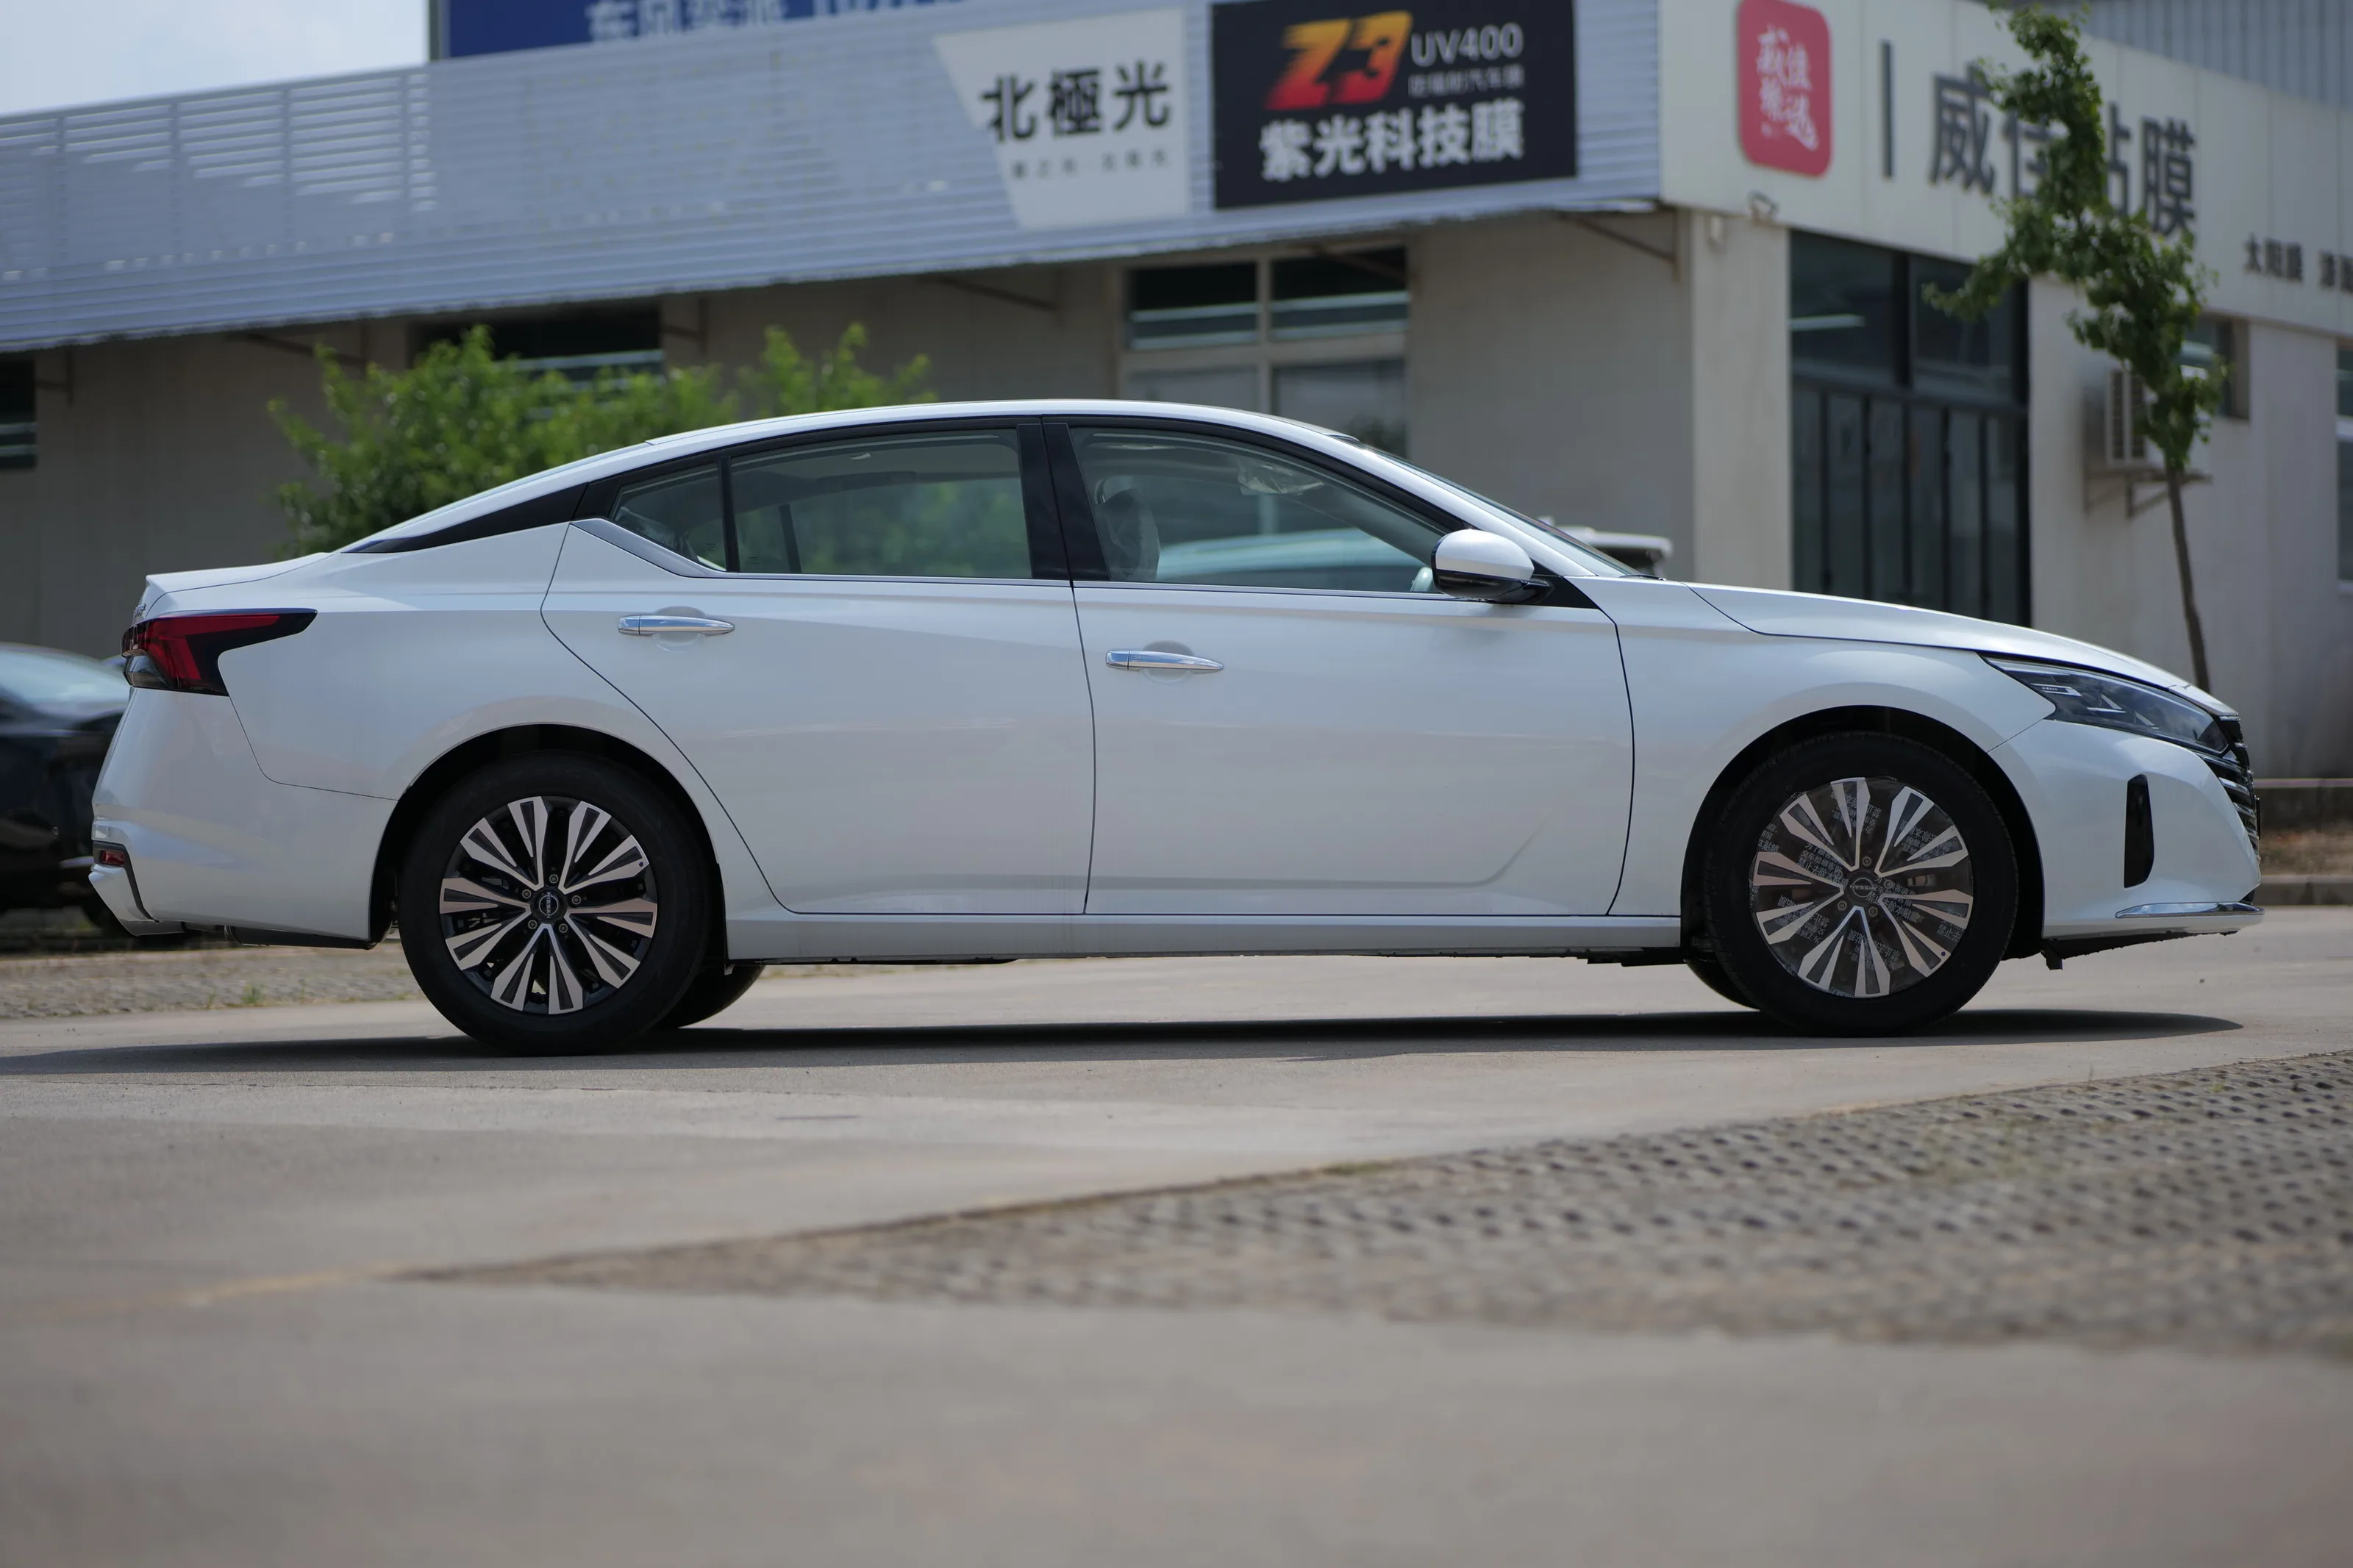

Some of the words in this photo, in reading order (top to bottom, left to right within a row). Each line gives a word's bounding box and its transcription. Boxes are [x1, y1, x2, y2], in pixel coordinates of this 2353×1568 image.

[1264, 10, 1413, 110] Z3
[1411, 22, 1523, 67] UV400
[980, 60, 1171, 143] 北極光
[1259, 97, 1525, 182] 紫光科技膜
